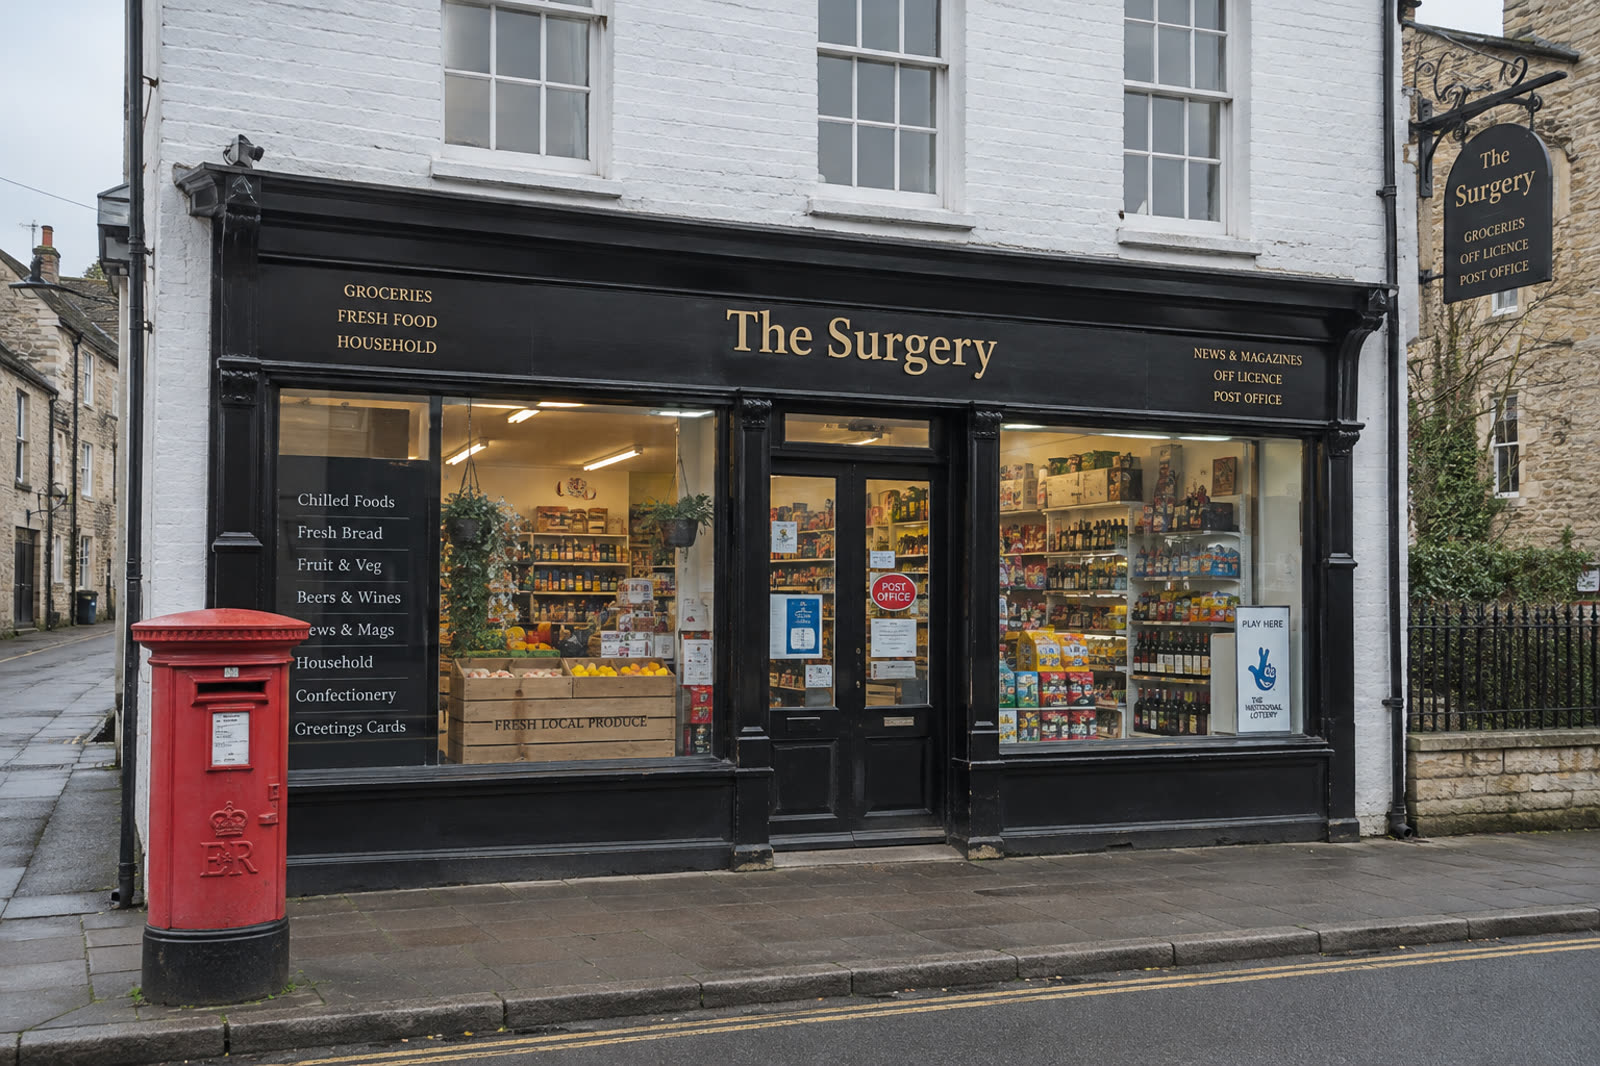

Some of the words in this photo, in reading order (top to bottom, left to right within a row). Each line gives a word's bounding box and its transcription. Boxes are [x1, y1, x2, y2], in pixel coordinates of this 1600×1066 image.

[1480, 149, 1510, 170] The
[1455, 170, 1536, 208] Surgery
[1464, 217, 1525, 243] GROCERIES
[1460, 250, 1480, 265] OFF
[1483, 239, 1529, 259] LICENCE
[1460, 270, 1487, 286] POST
[1489, 260, 1529, 279] OFFICE
[344, 284, 433, 303] GROCERIES
[338, 309, 388, 326] FRESH
[393, 313, 438, 329] FOOD
[337, 335, 437, 354] HOUSEHOLD
[726, 309, 813, 356] The
[827, 316, 998, 380] Surgery
[1193, 347, 1226, 361] NEWS
[1229, 350, 1237, 361] &
[1241, 351, 1303, 366] MAGAZINES
[1213, 369, 1235, 382] OFF
[1237, 371, 1283, 385] LICENCE
[1213, 390, 1241, 403] POST
[1244, 392, 1283, 405] OFFICE
[297, 492, 349, 507] Chilled
[354, 495, 395, 508] Foods
[297, 525, 337, 539] Fresh
[341, 526, 383, 540] Bread
[297, 558, 333, 571] Fruit
[338, 558, 351, 572] &
[355, 559, 382, 575] Veg
[882, 582, 906, 591] POST
[297, 591, 336, 604] Beers
[340, 590, 352, 604] &
[358, 591, 401, 604] Wines
[308, 625, 336, 636] ews
[340, 623, 352, 636] &
[358, 623, 395, 639] Mags
[1242, 620, 1261, 628] PLAY
[1263, 620, 1284, 628] HERE
[296, 655, 373, 669] Household
[296, 688, 397, 704] Confectionery
[295, 721, 363, 737] Greetings
[366, 720, 407, 733] Cards
[495, 719, 537, 731] FRESH
[541, 717, 584, 730] LOCAL
[588, 715, 648, 729] PRODUCE
